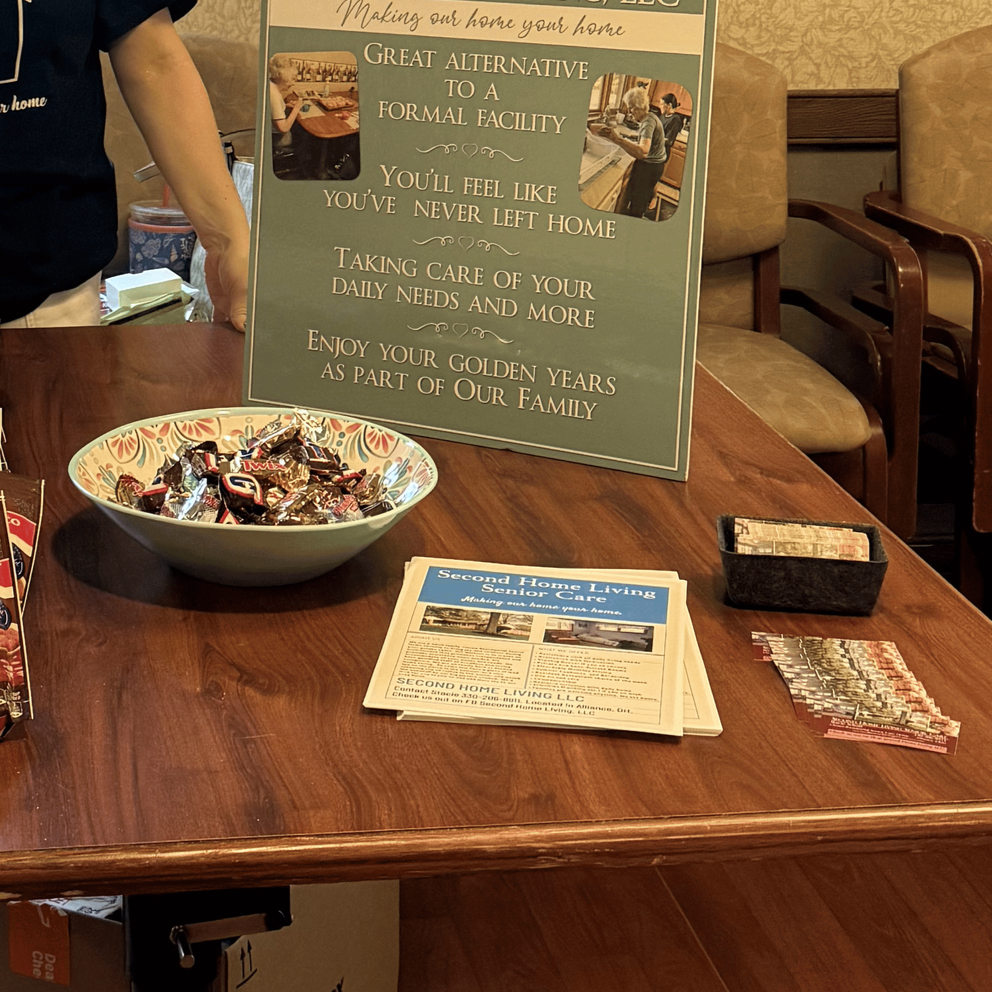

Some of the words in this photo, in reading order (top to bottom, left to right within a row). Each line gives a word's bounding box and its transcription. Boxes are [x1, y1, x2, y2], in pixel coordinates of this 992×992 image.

[431, 12, 461, 28] our
[466, 7, 515, 31] home
[522, 17, 569, 38] your
[573, 15, 626, 38] home
[363, 42, 437, 69] GREAT
[445, 52, 589, 81] ALTERNATIVE
[11, 95, 47, 111] home
[445, 78, 476, 99] TO
[484, 82, 500, 101] A
[378, 101, 468, 126] FORMAL
[477, 109, 567, 134] FACILITY
[463, 177, 504, 199] FEEL
[514, 182, 558, 205] LIKE
[323, 189, 397, 215] YOU'VE
[414, 199, 484, 224] NEVER
[493, 207, 539, 229] LEFT
[547, 213, 617, 240] HOME
[334, 246, 418, 278] TAKING
[426, 260, 484, 287] CARE
[493, 269, 522, 290] OF
[531, 274, 596, 301] YOUR
[332, 276, 389, 301] DAILY
[396, 285, 460, 311] NEEDS
[468, 294, 518, 318] AND
[527, 303, 595, 329] MORE
[307, 329, 370, 359] ENJOY
[379, 342, 439, 369] YOUR
[448, 353, 538, 383] GOLDEN
[546, 367, 617, 396] YEARS
[321, 361, 346, 382] AS
[353, 366, 409, 391] PART
[417, 375, 445, 396] OF
[453, 377, 508, 407] OUR
[518, 387, 598, 421] FAMILY
[242, 460, 286, 471] Twix
[437, 570, 510, 585] Second
[518, 576, 581, 591] Home
[589, 583, 656, 600] Living
[481, 584, 548, 598] Senior
[555, 591, 607, 603] Care
[460, 595, 503, 607] Making
[529, 601, 559, 610] home
[394, 685, 429, 694] Contact
[526, 699, 563, 707] Located
[396, 677, 455, 690] SECOND
[459, 684, 500, 694] HOME
[504, 689, 552, 699] LIVING
[557, 694, 585, 702] LLC
